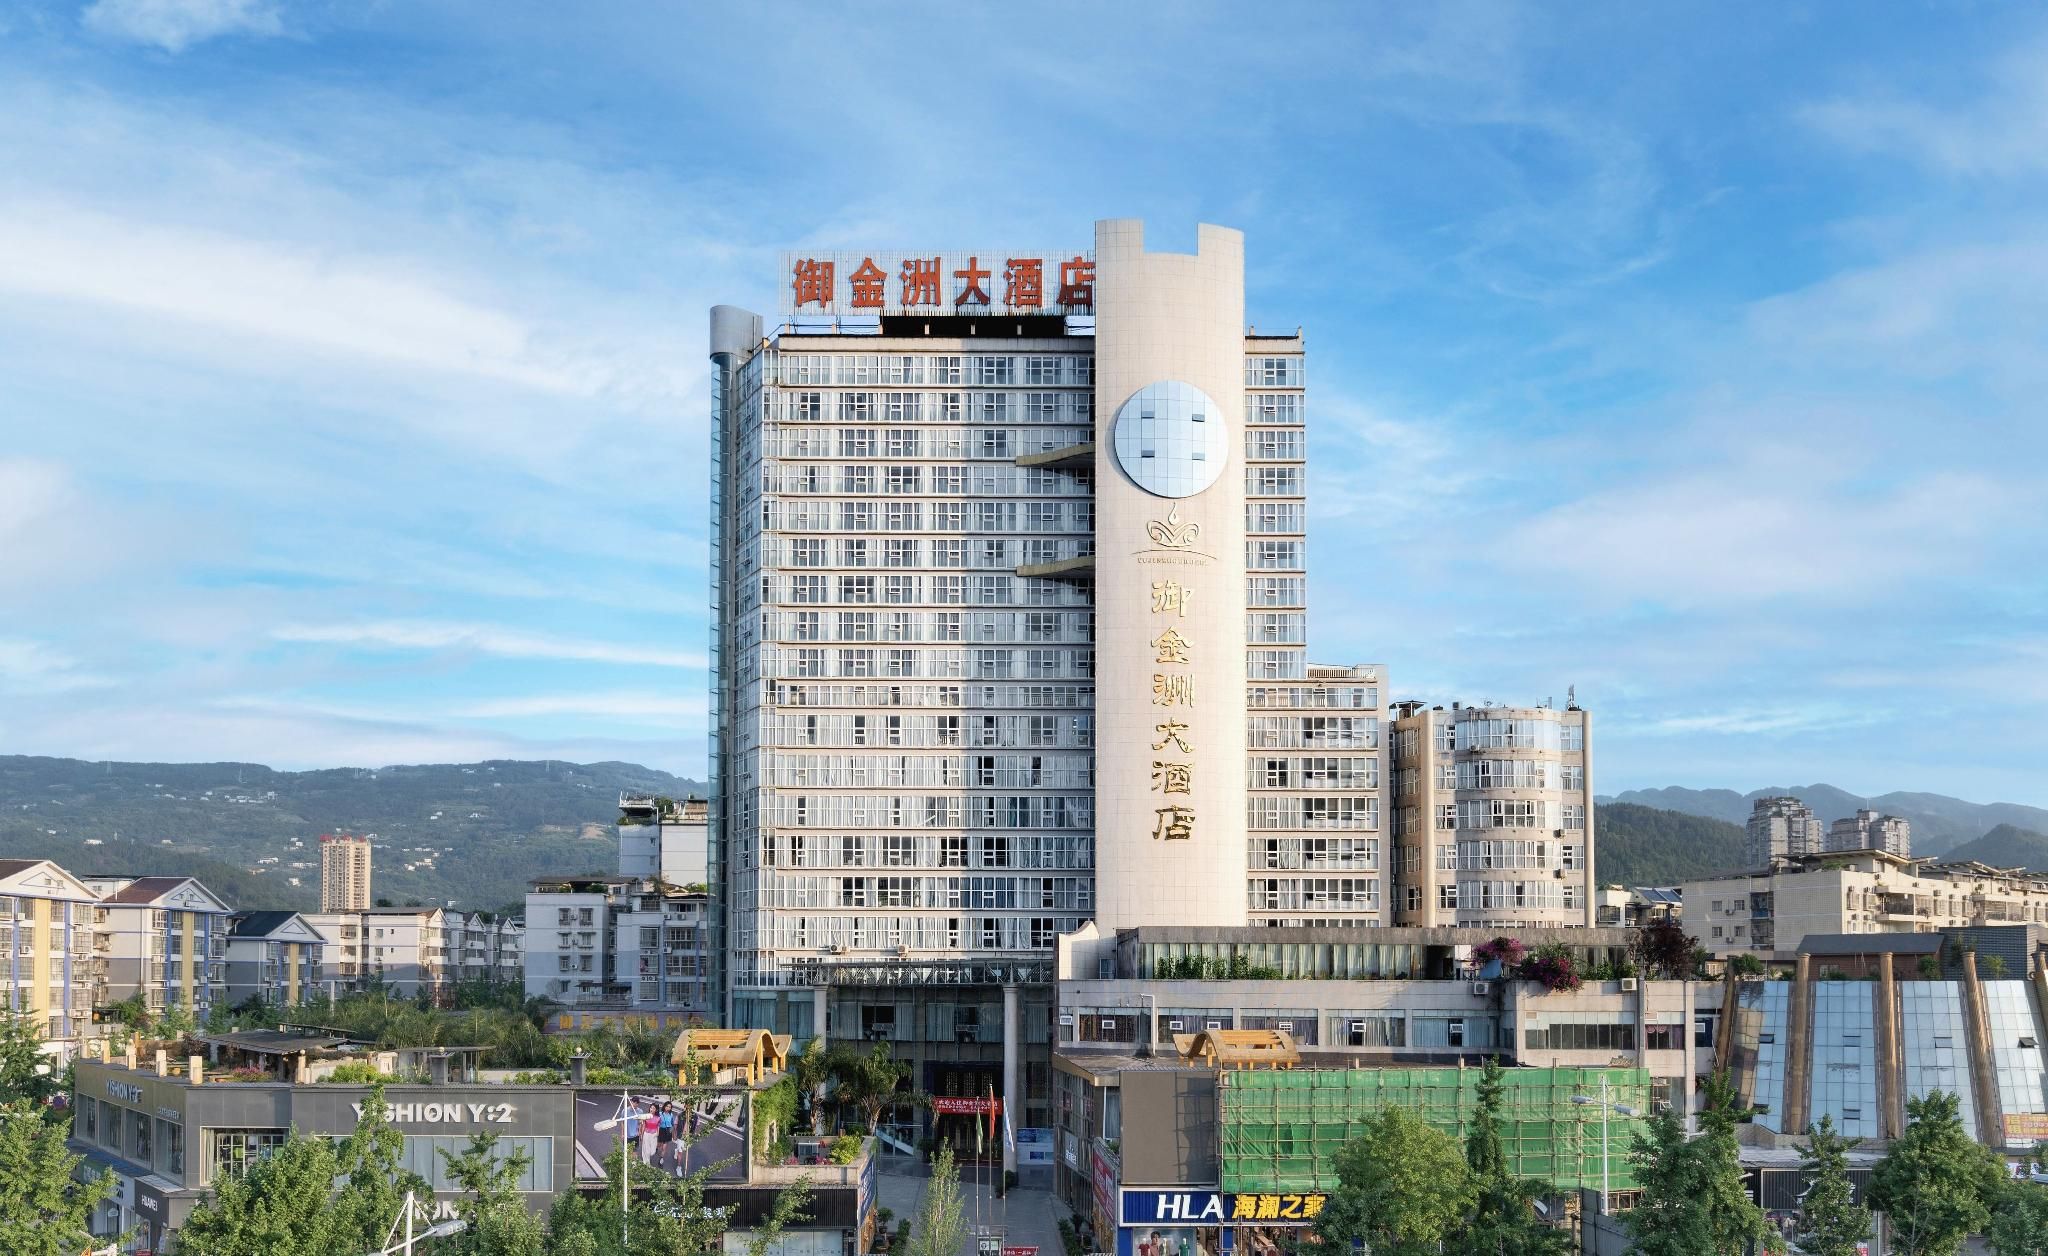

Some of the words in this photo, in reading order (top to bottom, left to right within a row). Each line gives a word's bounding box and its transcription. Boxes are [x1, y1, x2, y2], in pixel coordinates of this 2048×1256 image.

[793, 256, 1095, 308] 御金洲大酒店
[1151, 579, 1195, 840] 御金洲大酒店
[351, 1103, 461, 1123] YSHION
[1157, 1194, 1224, 1219] HLA
[1232, 1194, 1326, 1218] 海澜之家
